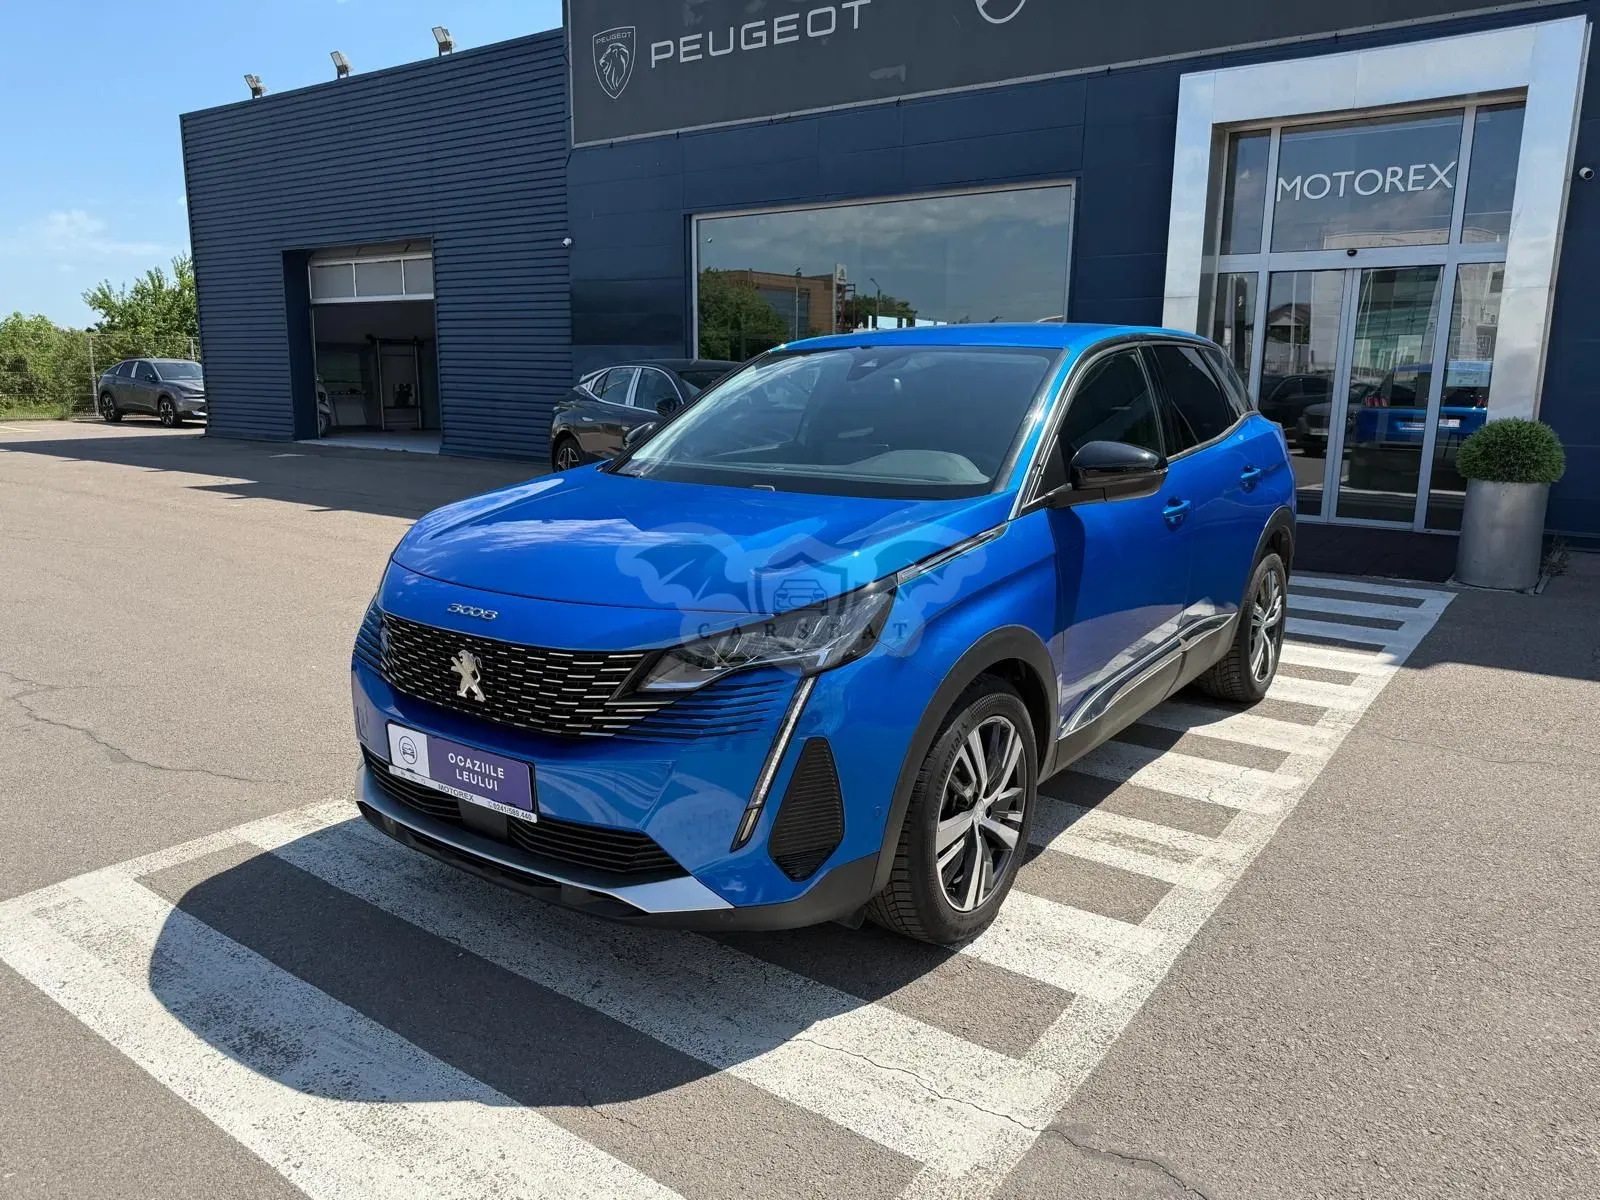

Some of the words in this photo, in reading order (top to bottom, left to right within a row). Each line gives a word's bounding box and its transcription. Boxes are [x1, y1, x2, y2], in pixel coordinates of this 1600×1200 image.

[596, 31, 632, 44] PEUGEOT
[651, 0, 871, 68] PEUGEOT
[1276, 161, 1456, 202] MOTOREX
[447, 603, 498, 620] 3008
[448, 752, 504, 779] OCAZIILE
[456, 768, 498, 791] LEULUI
[438, 783, 474, 802] MOTOREX
